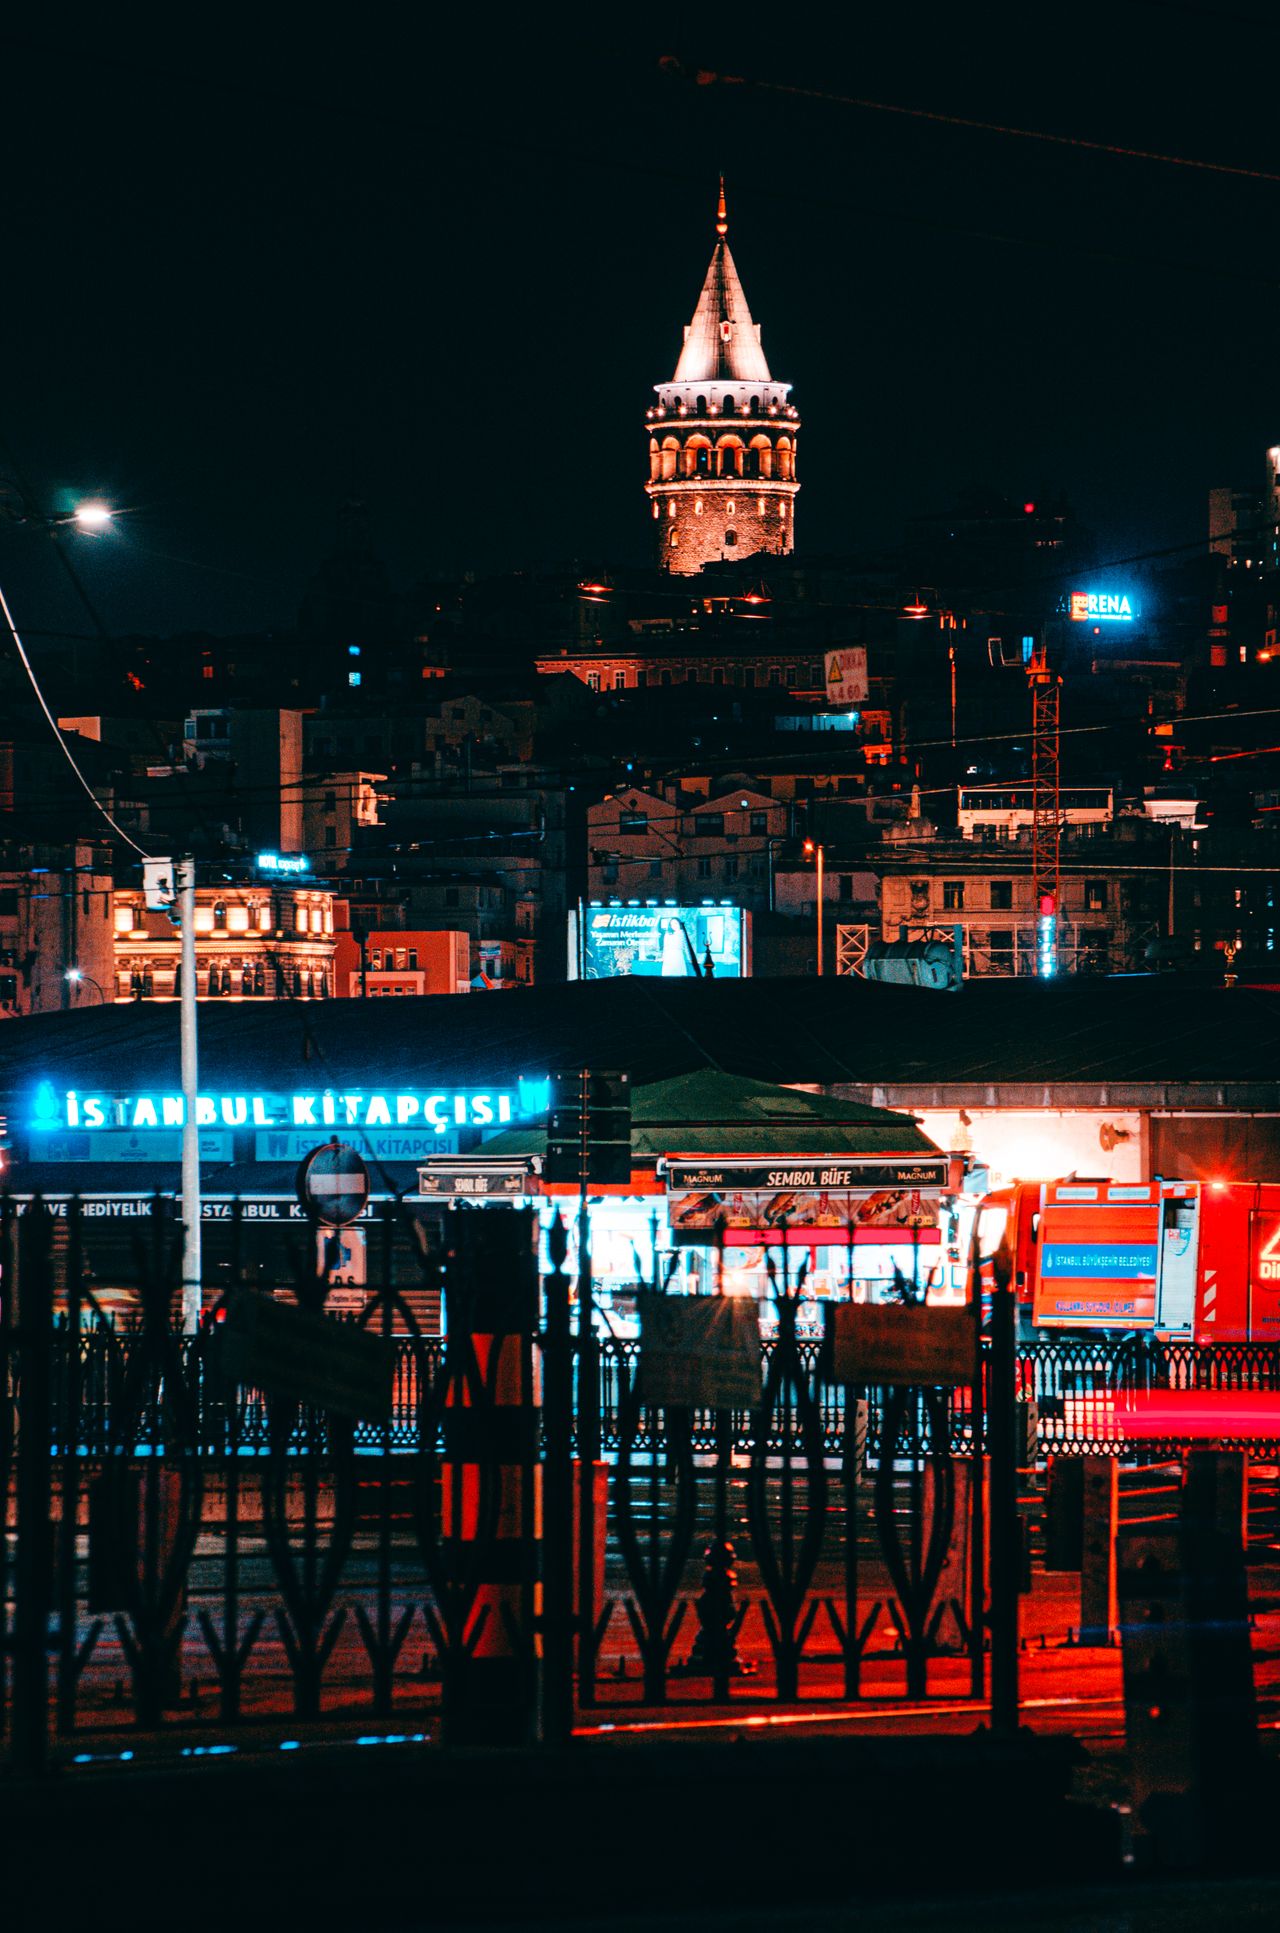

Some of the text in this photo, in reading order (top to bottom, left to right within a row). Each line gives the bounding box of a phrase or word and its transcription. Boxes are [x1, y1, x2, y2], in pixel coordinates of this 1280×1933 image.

[66, 1088, 511, 1134] İSTANBUL KİTAPÇISI
[683, 1168, 937, 1186] MAGNUM SEMBOL BÜFE MAGNUM
[49, 1203, 68, 1217] VE
